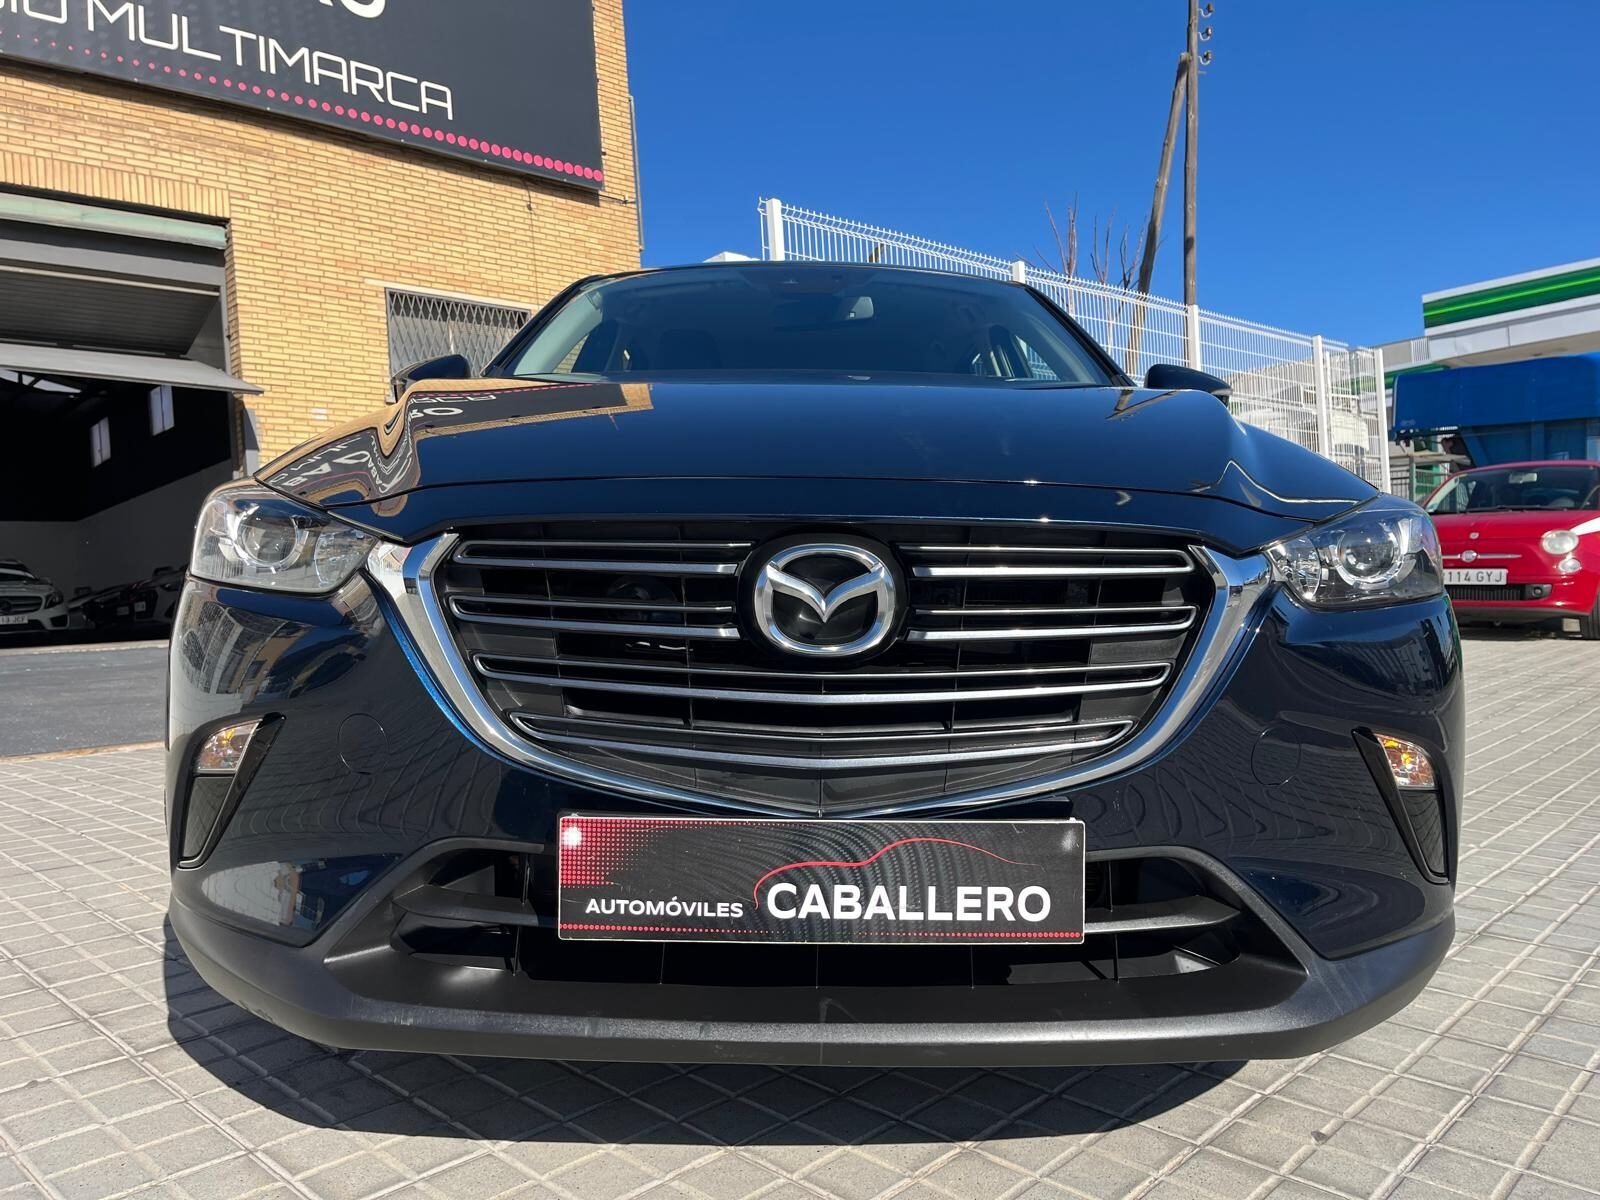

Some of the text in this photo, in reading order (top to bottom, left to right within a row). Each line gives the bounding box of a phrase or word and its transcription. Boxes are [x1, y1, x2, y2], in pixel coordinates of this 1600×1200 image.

[87, 0, 453, 121] MULTIMARCA
[1443, 571, 1502, 582] 114 GYJ
[585, 883, 1051, 922] AUTOMÓVILES CABALLERO
